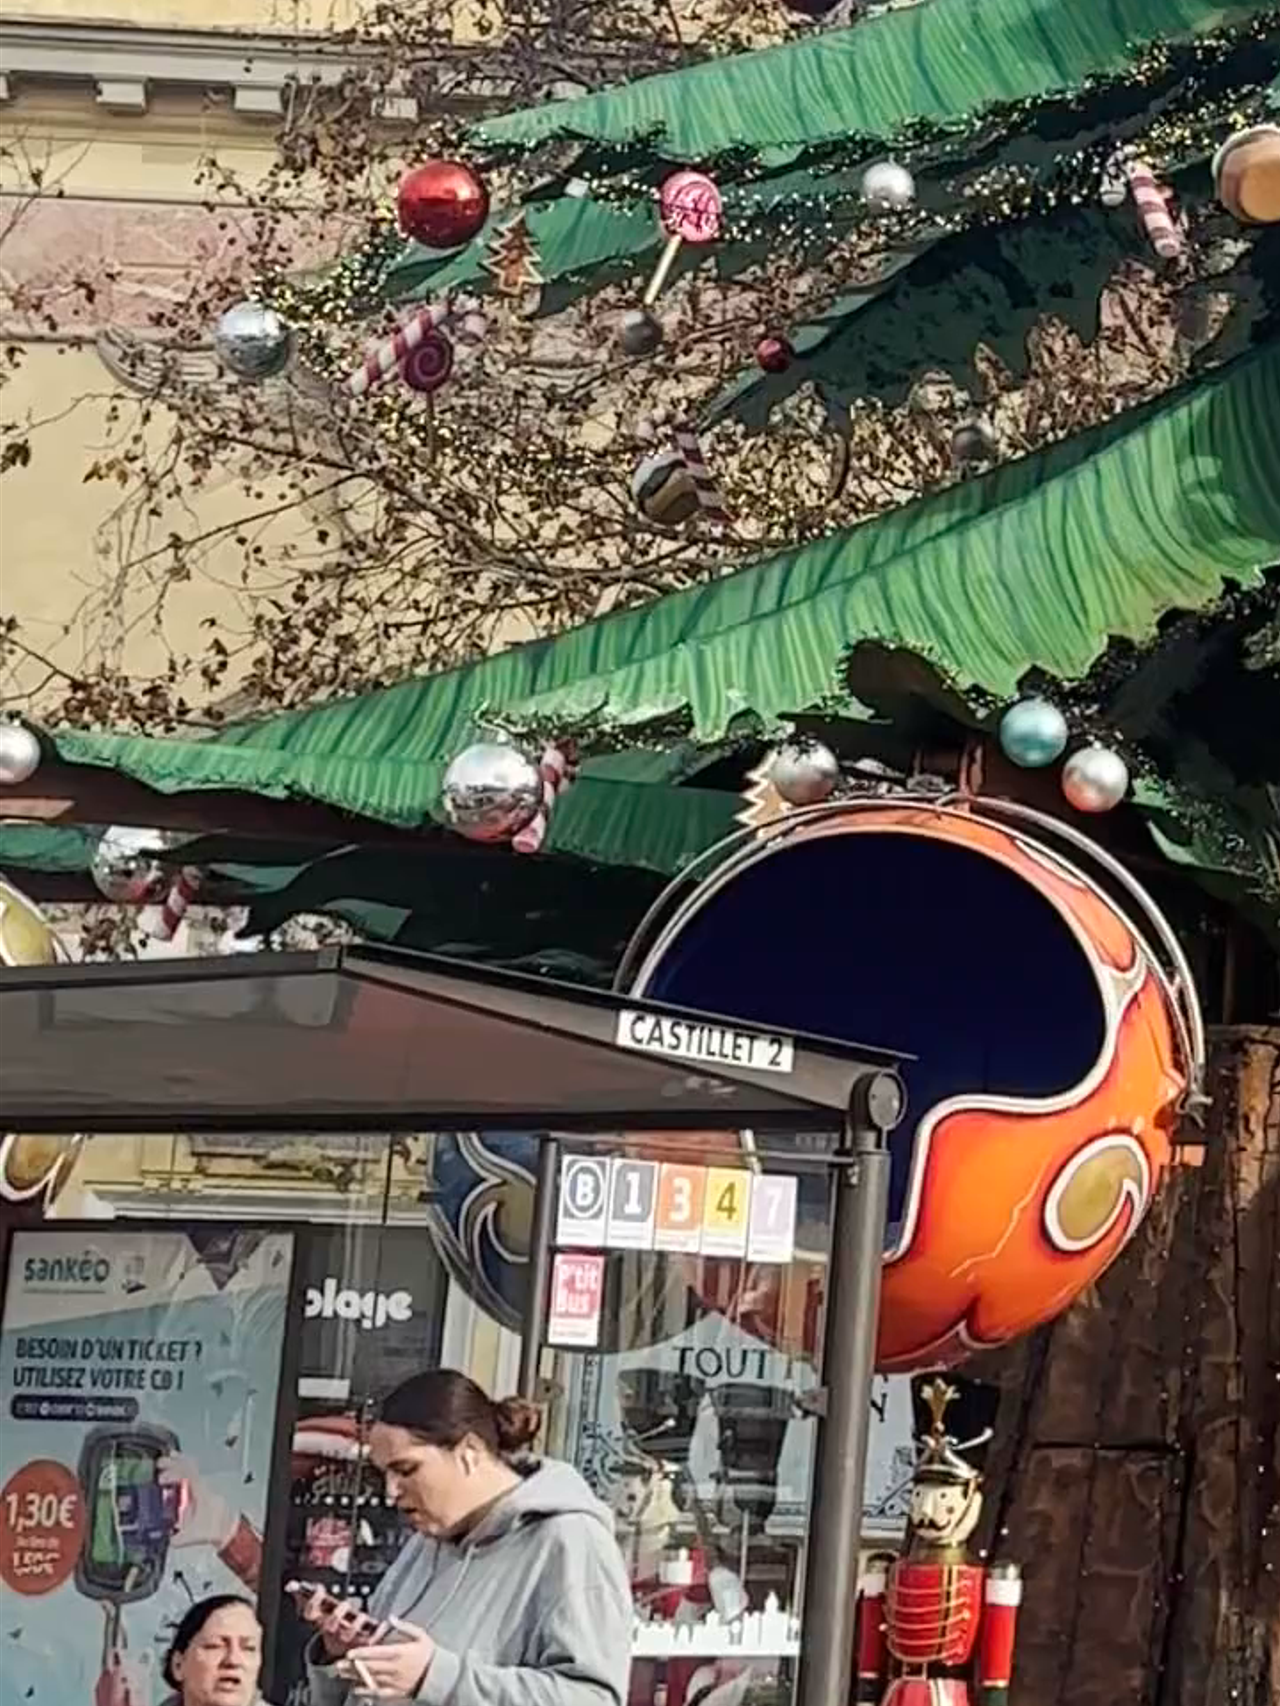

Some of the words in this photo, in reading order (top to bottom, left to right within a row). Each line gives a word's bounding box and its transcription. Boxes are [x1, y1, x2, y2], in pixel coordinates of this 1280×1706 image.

[630, 1015, 757, 1064] CASTILLET
[768, 1037, 783, 1067] 2
[574, 1173, 595, 1206] B
[623, 1171, 642, 1214] 1
[669, 1176, 693, 1222] 3
[715, 1181, 737, 1220] 4
[766, 1186, 782, 1227] 7
[24, 1248, 110, 1283] sankéo
[16, 1338, 77, 1359] BESOIN
[128, 1340, 191, 1361] TICKET
[673, 1346, 769, 1379] TOUT
[13, 1367, 86, 1389] UTILISEZ
[90, 1368, 145, 1390] VOTRE
[6, 1492, 78, 1533] 1,30€
